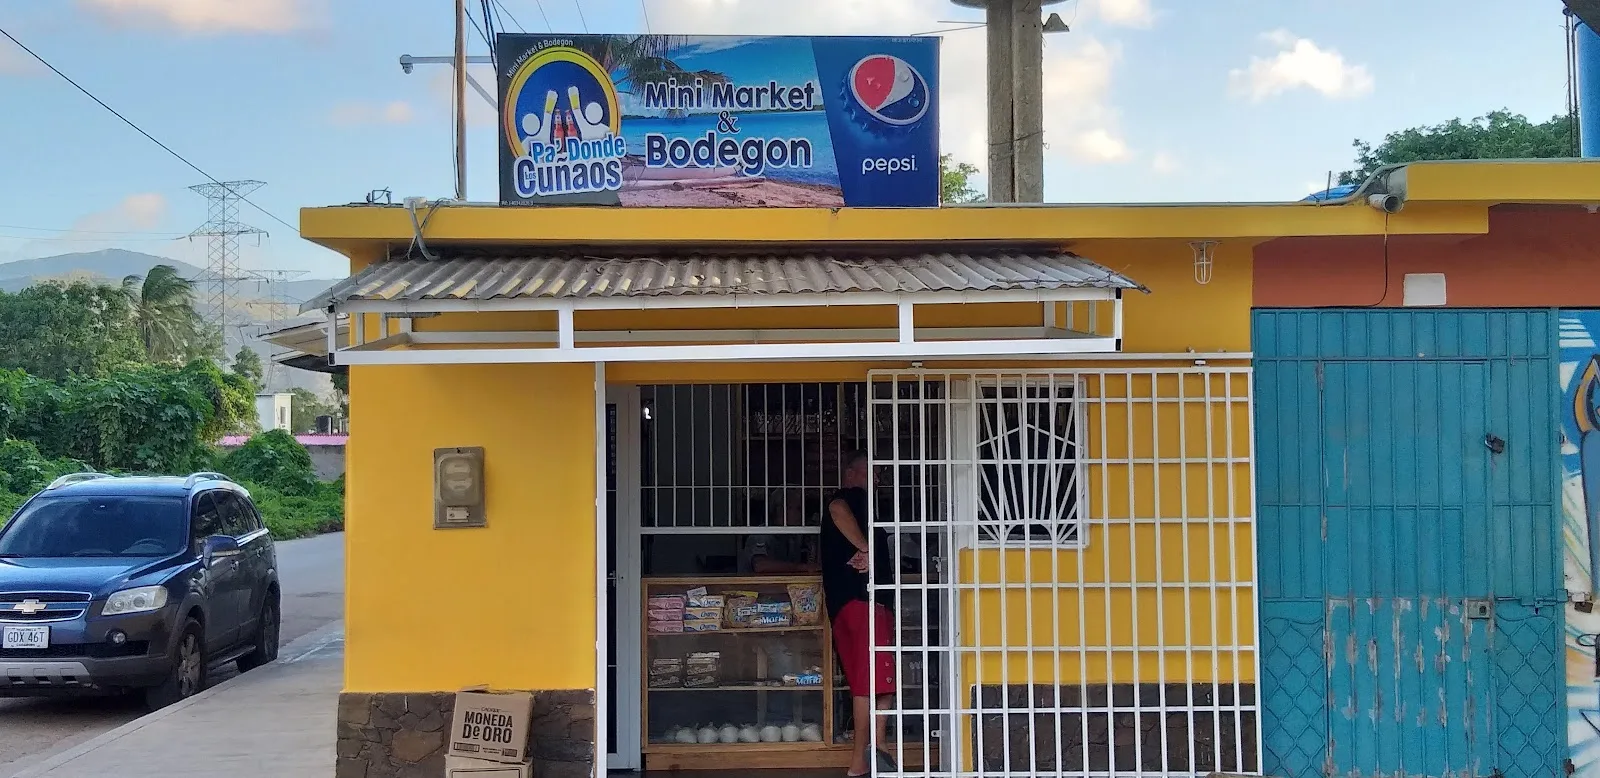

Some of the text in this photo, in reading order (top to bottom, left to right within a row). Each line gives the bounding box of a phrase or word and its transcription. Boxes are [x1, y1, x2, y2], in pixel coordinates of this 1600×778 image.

[506, 38, 574, 79] Mini Market & Bodegon
[646, 78, 814, 109] Mini Market
[717, 110, 741, 134] &
[567, 132, 625, 161] Donde
[646, 133, 812, 176] Bodegon
[516, 156, 621, 195] Cuñaos
[525, 171, 537, 180] Los
[862, 155, 916, 175] pepsi
[7, 632, 45, 643] GDX 46T
[464, 711, 513, 728] MONEDA
[482, 726, 513, 743] ORO
